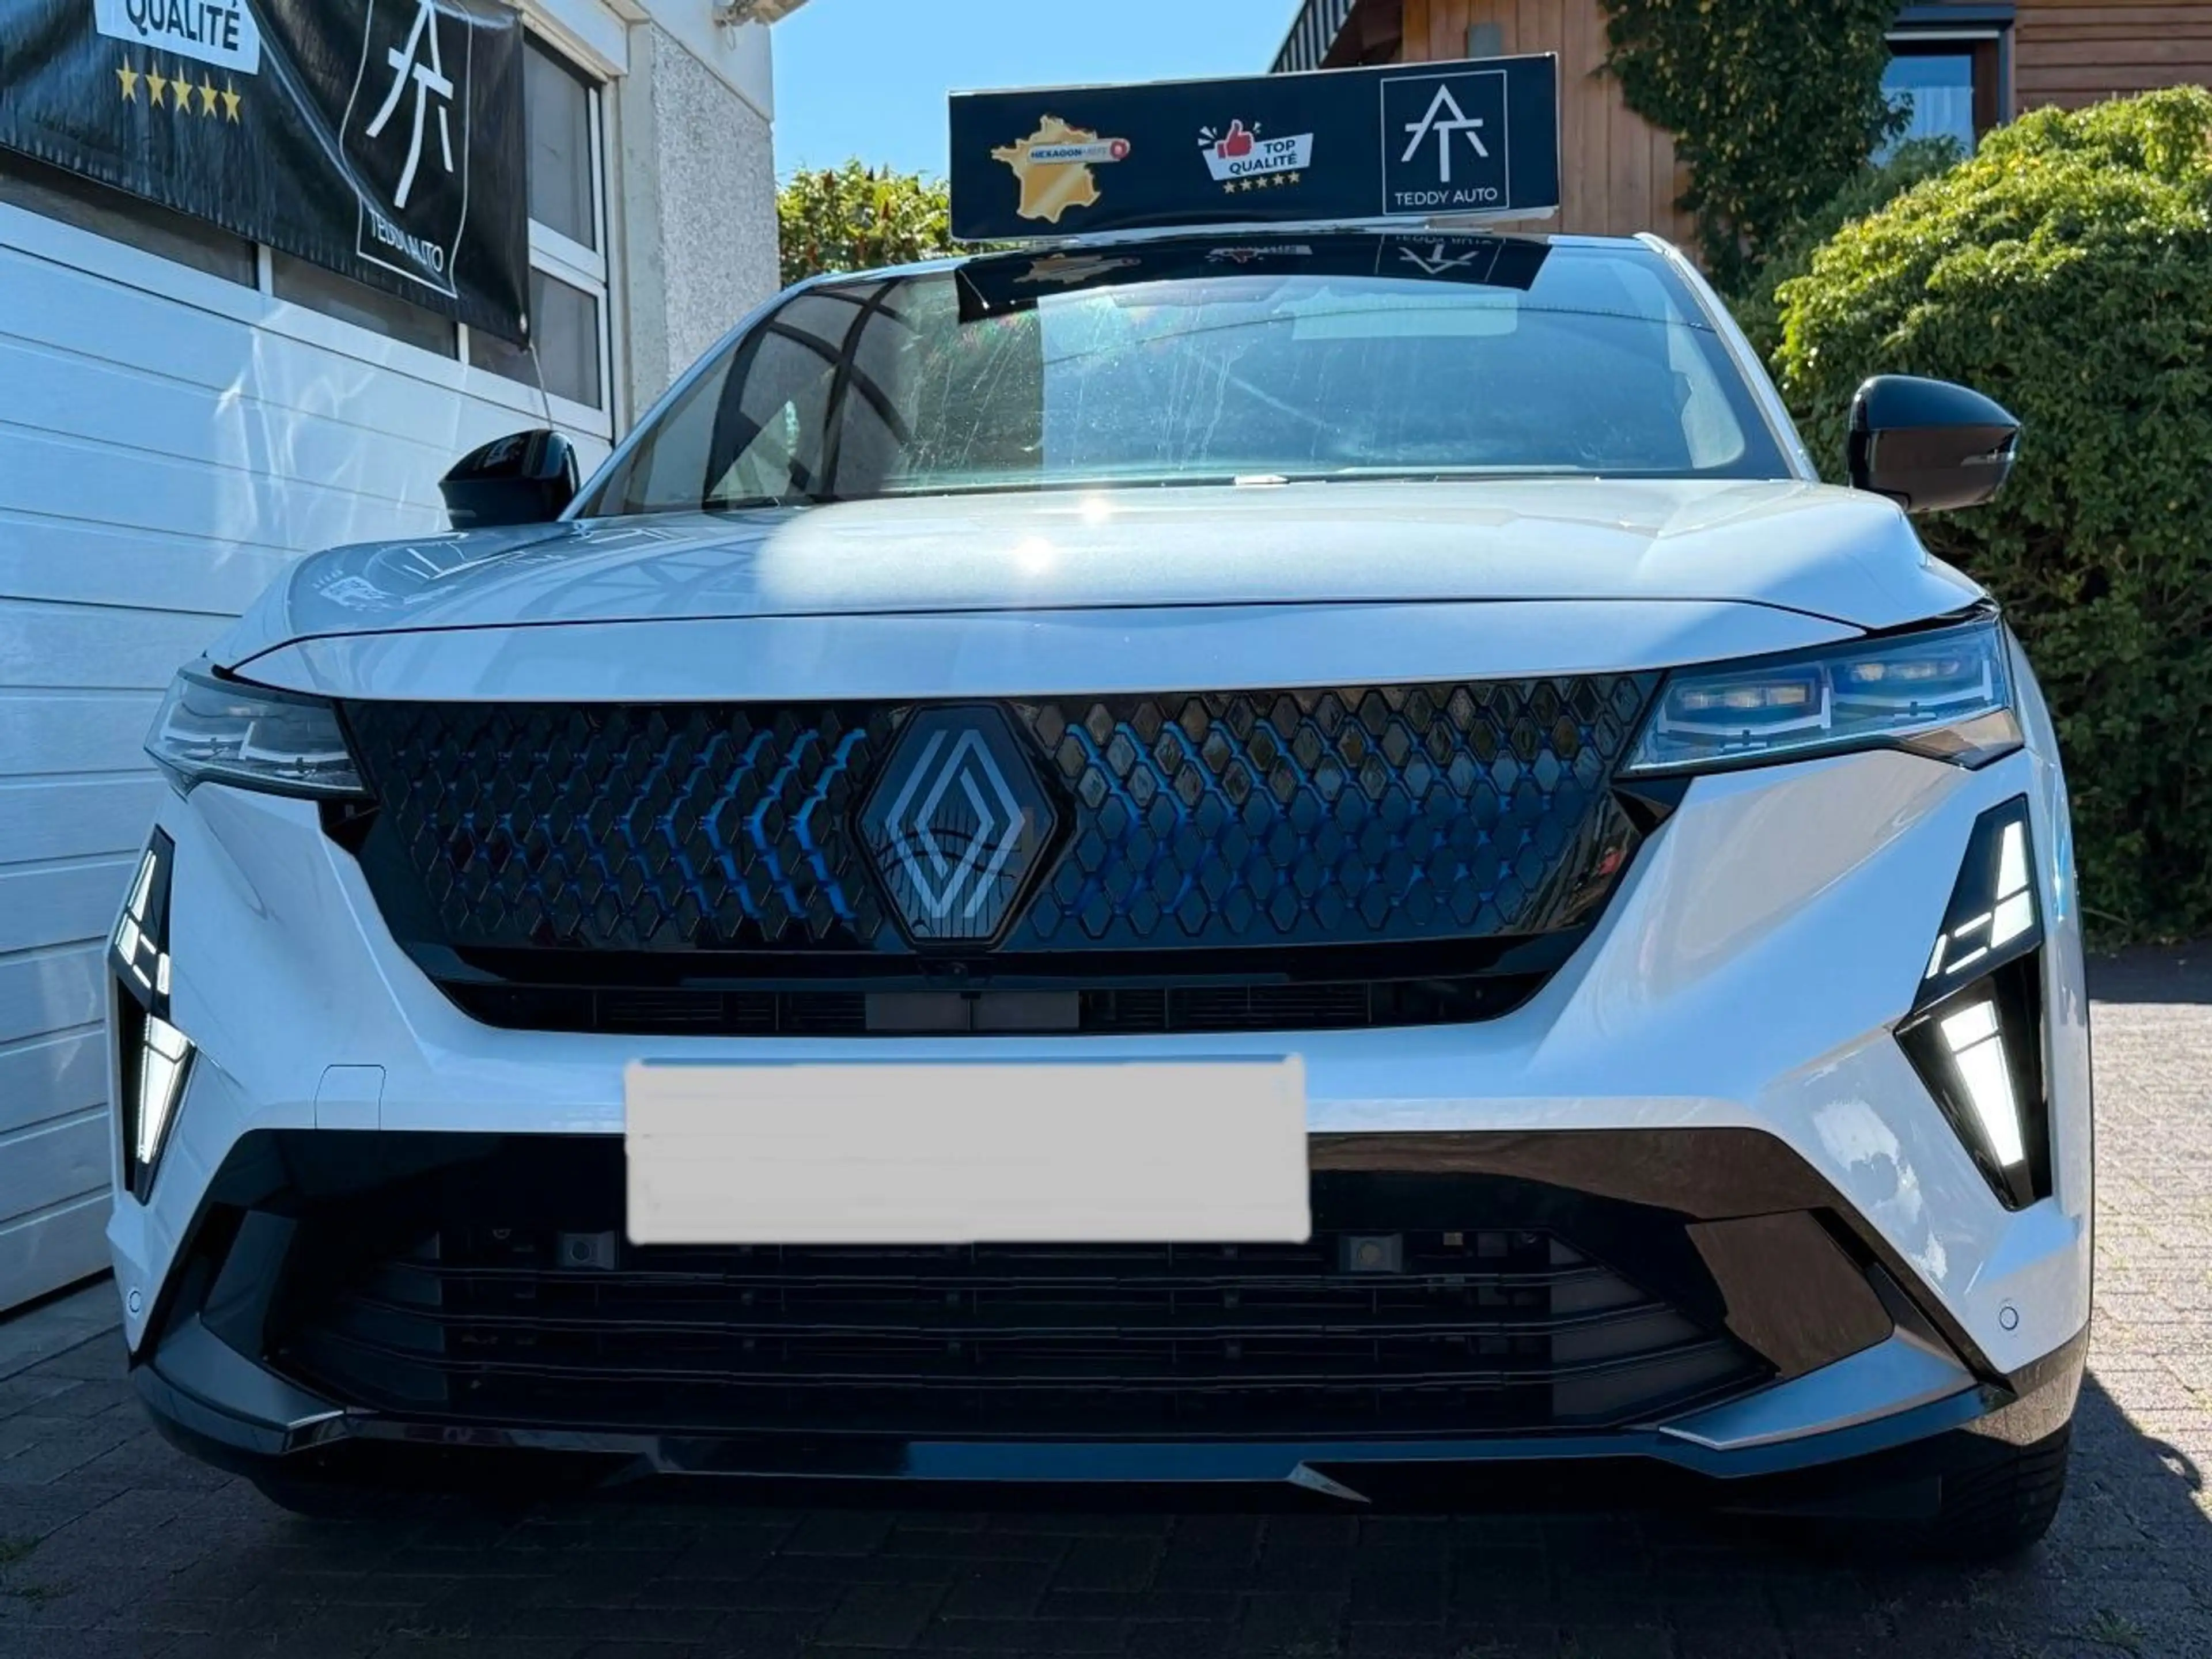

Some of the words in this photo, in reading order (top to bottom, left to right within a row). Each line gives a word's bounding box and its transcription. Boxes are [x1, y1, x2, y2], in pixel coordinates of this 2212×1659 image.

[1264, 139, 1296, 154] TOP
[1229, 153, 1297, 175] QUALITÉ
[1395, 189, 1449, 206] TEDDY
[1453, 187, 1498, 203] AUTO
